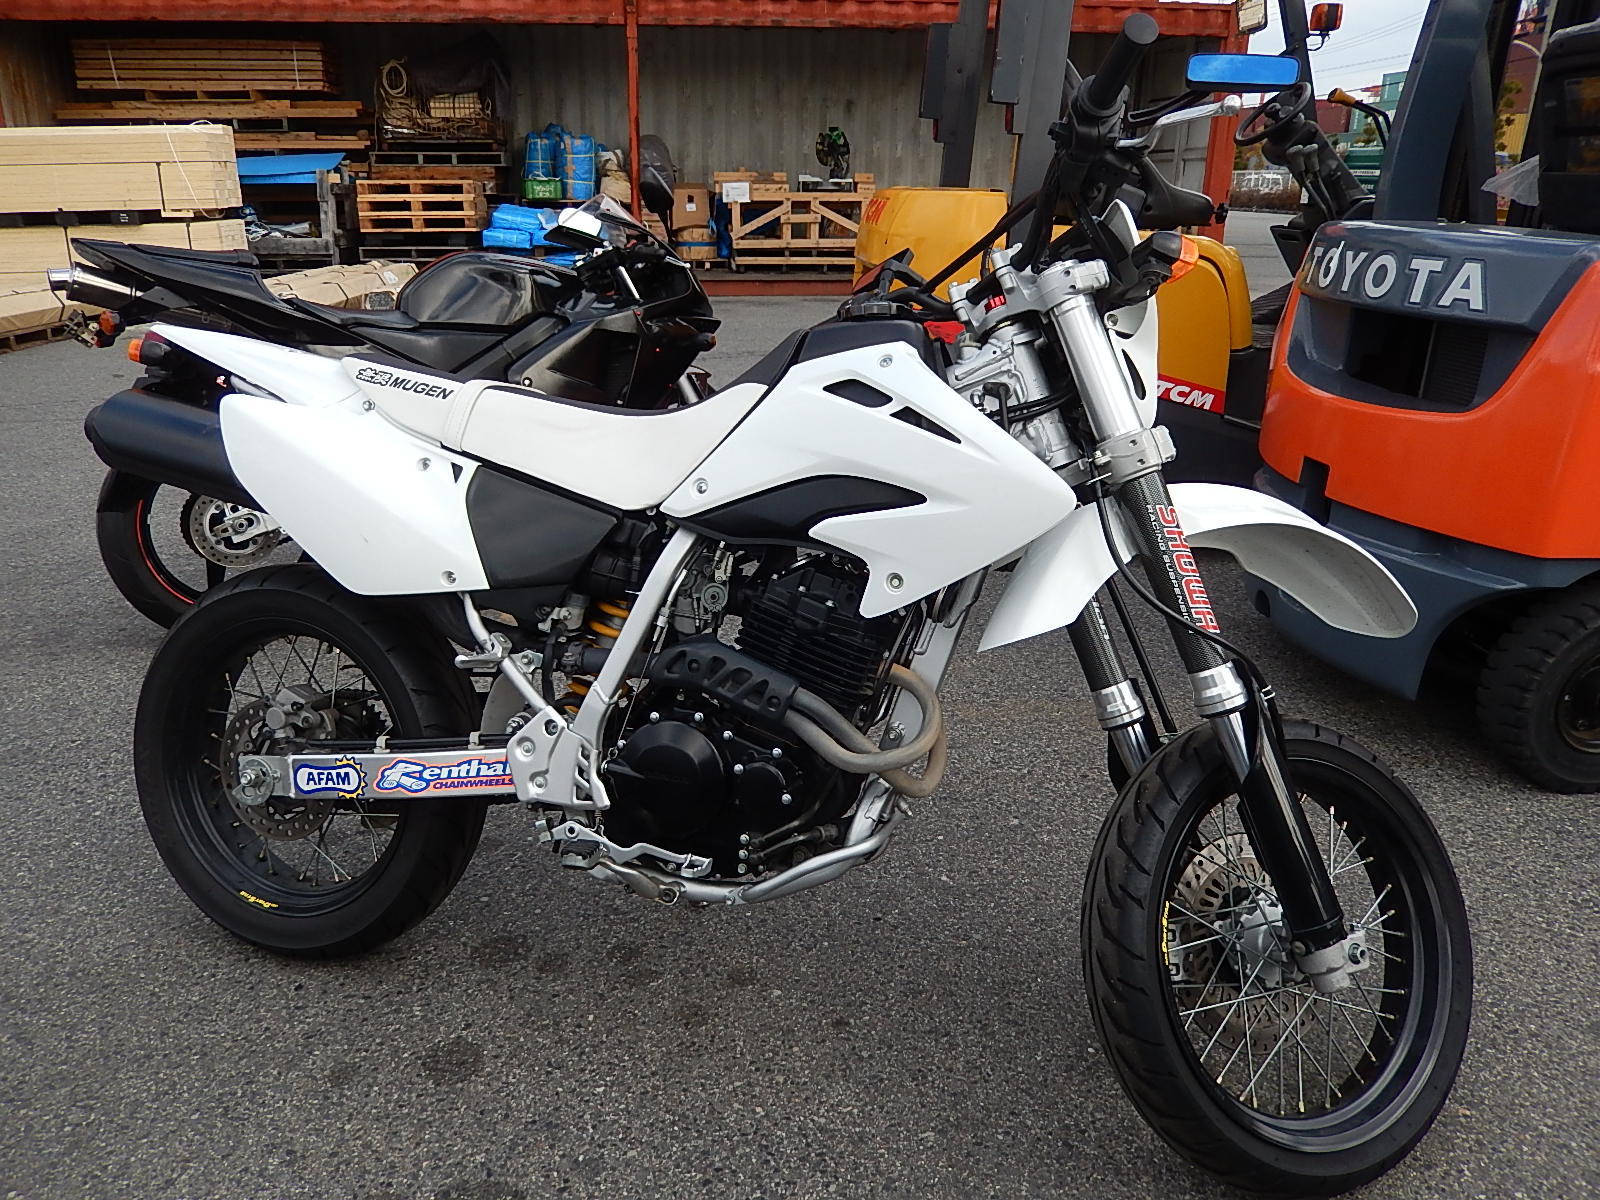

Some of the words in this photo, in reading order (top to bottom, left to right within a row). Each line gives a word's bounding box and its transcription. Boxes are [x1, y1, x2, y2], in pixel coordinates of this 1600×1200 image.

[1306, 245, 1483, 311] TOYOTA
[388, 376, 455, 400] MUGEN
[1157, 379, 1215, 410] TCM
[1146, 504, 1167, 551] RACING
[1163, 554, 1195, 634] SUSPENSIO
[1156, 504, 1221, 634] SHOWA
[305, 771, 351, 786] AFAM
